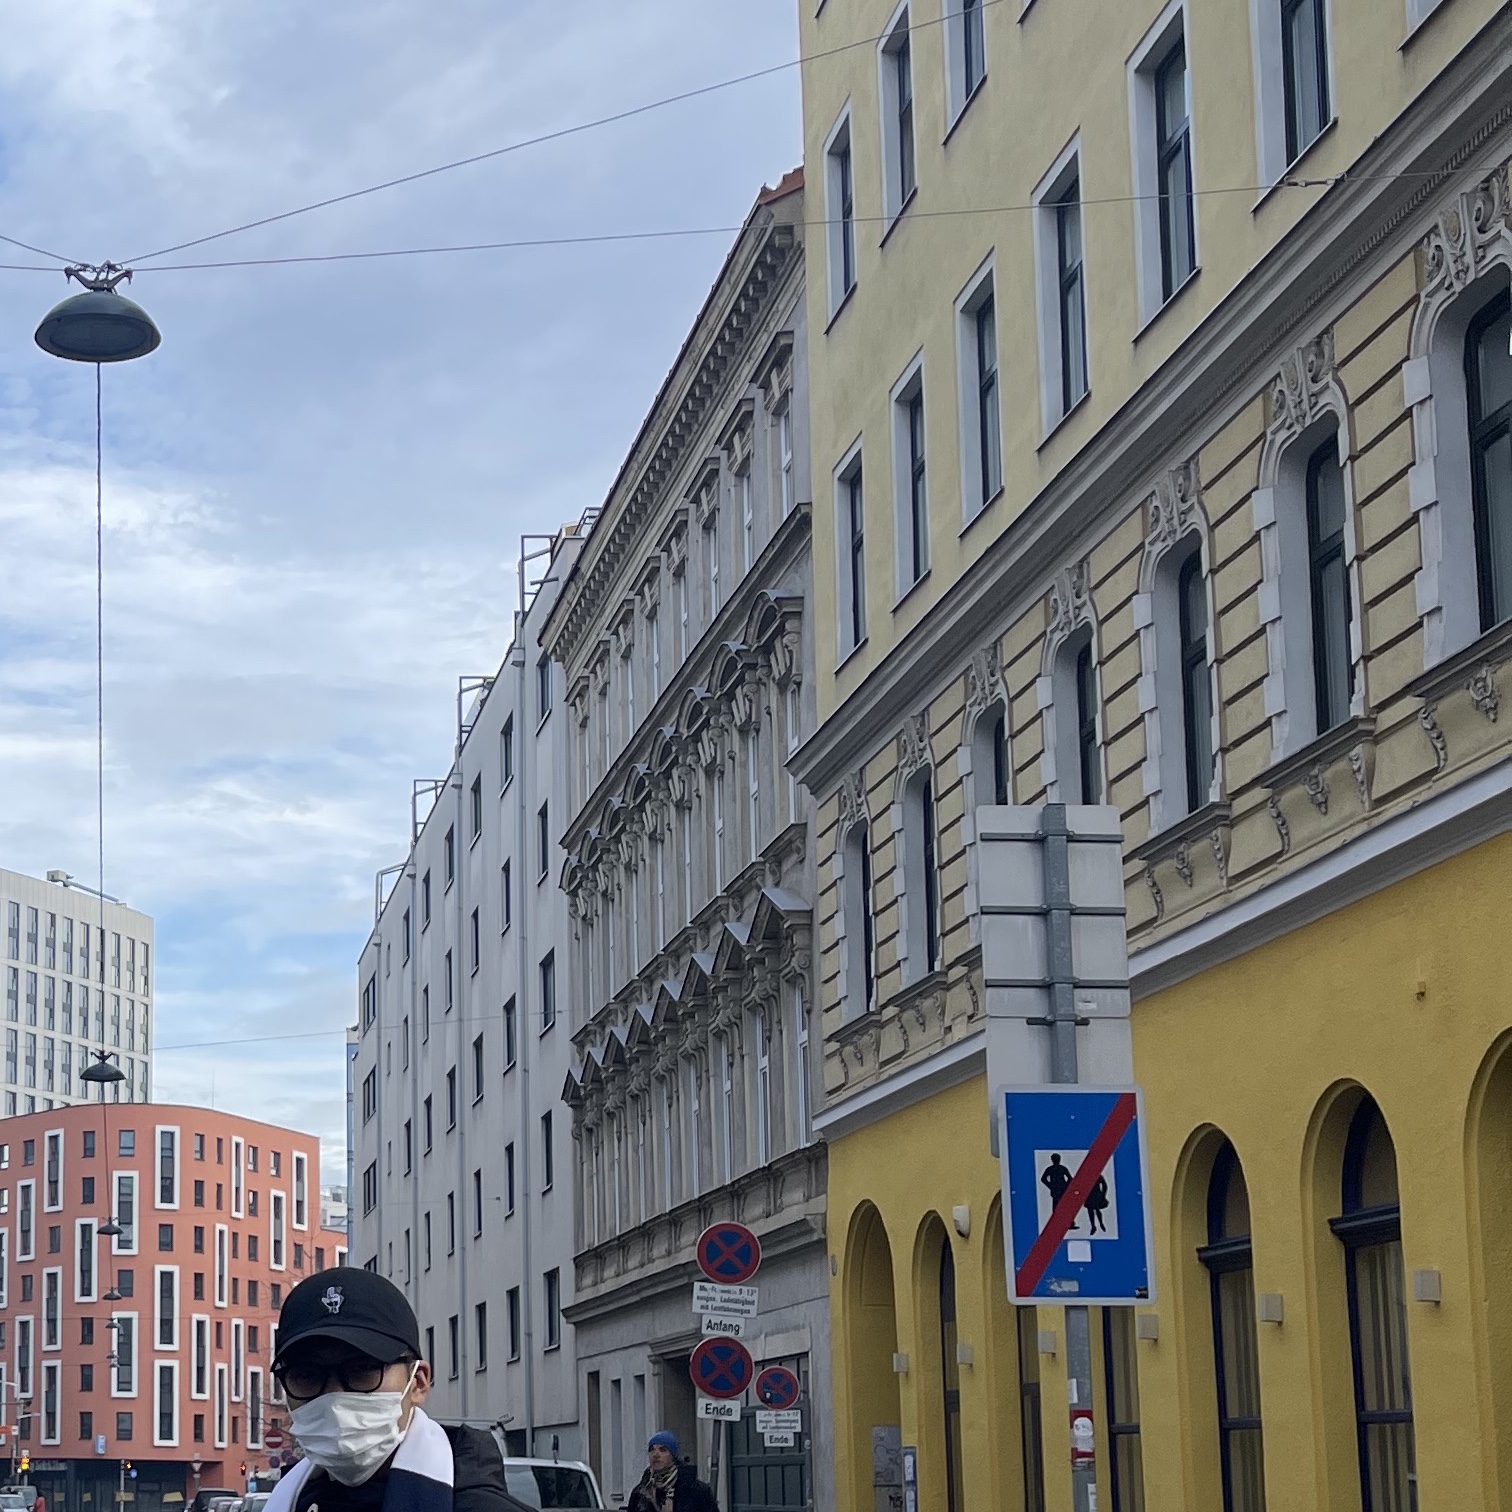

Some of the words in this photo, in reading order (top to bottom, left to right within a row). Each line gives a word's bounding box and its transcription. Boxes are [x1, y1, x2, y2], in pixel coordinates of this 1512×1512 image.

[706, 1319, 740, 1336] Anfang
[705, 1402, 733, 1417] Ende
[769, 1434, 789, 1445] Ende
